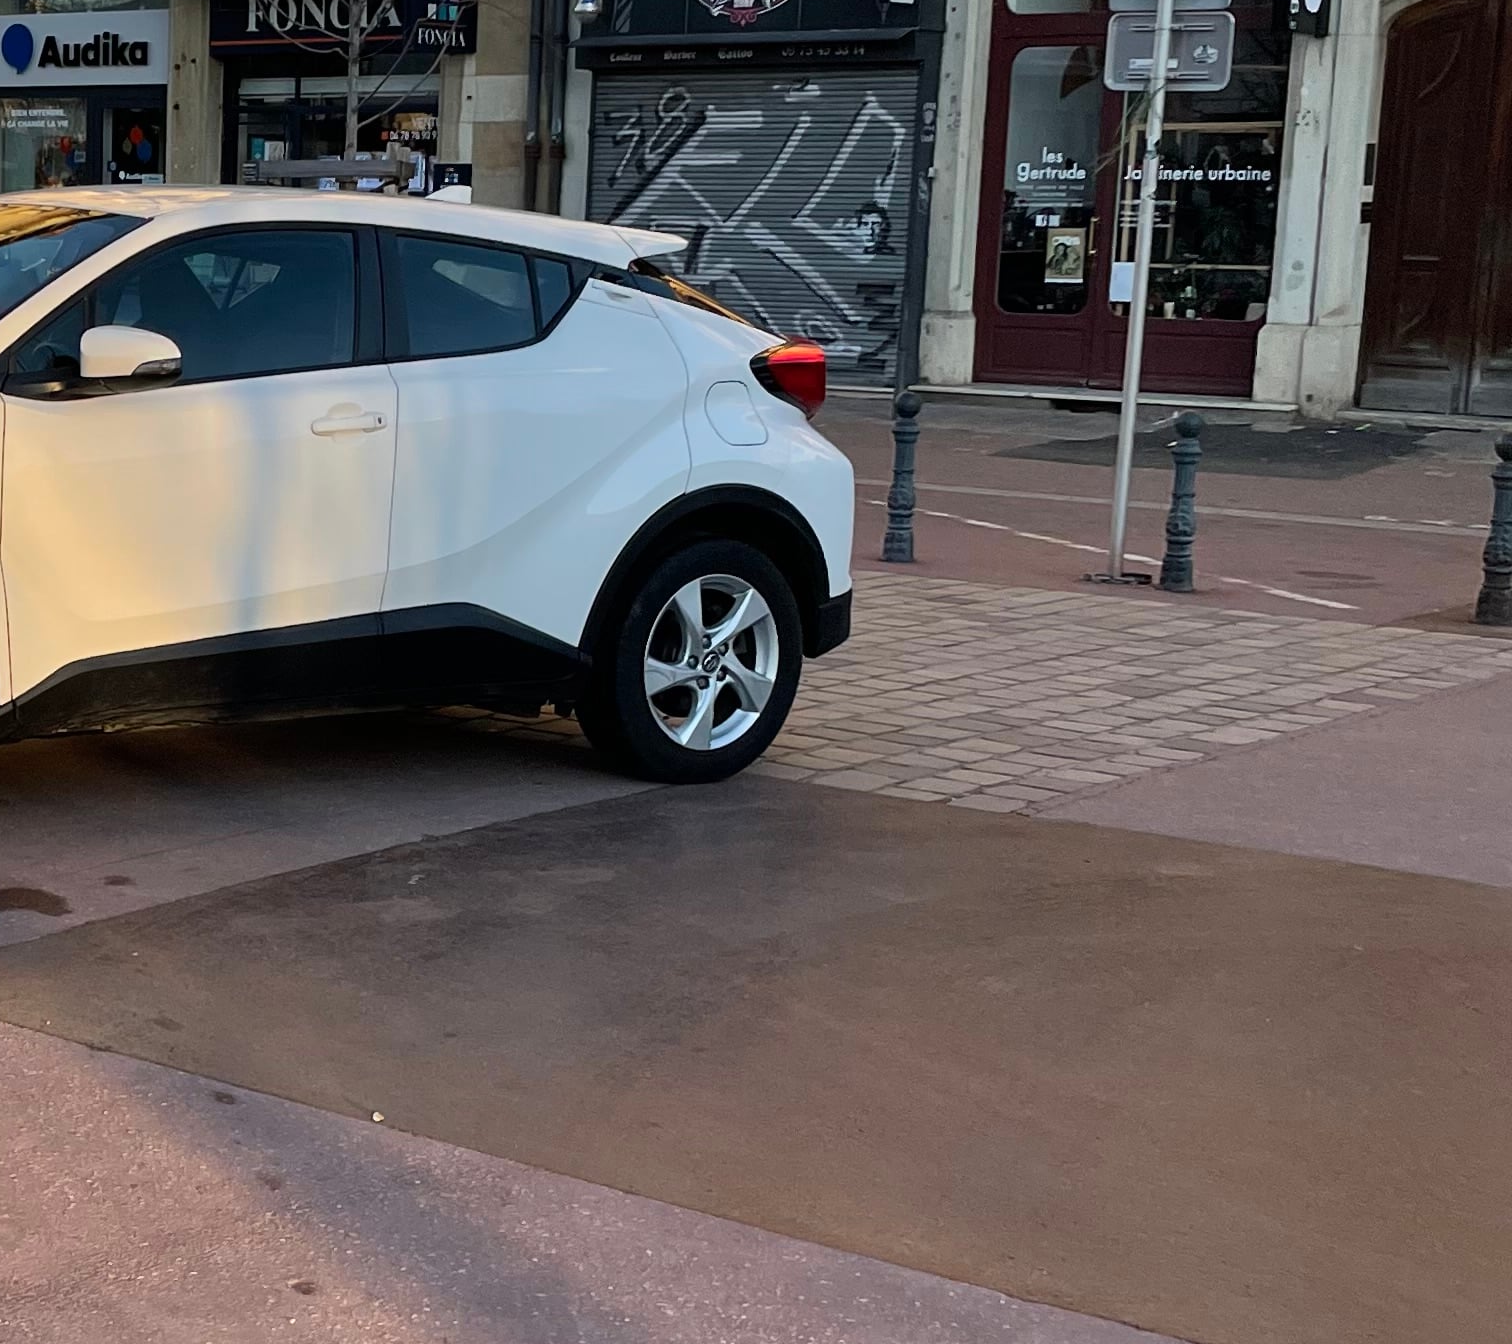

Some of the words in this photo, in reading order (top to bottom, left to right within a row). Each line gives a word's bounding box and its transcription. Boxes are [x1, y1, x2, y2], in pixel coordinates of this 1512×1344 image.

[417, 27, 466, 47] FONCIA
[38, 31, 150, 68] Audika
[1041, 146, 1063, 164] les
[1016, 161, 1087, 183] gertrude
[1207, 164, 1272, 182] urbaine
